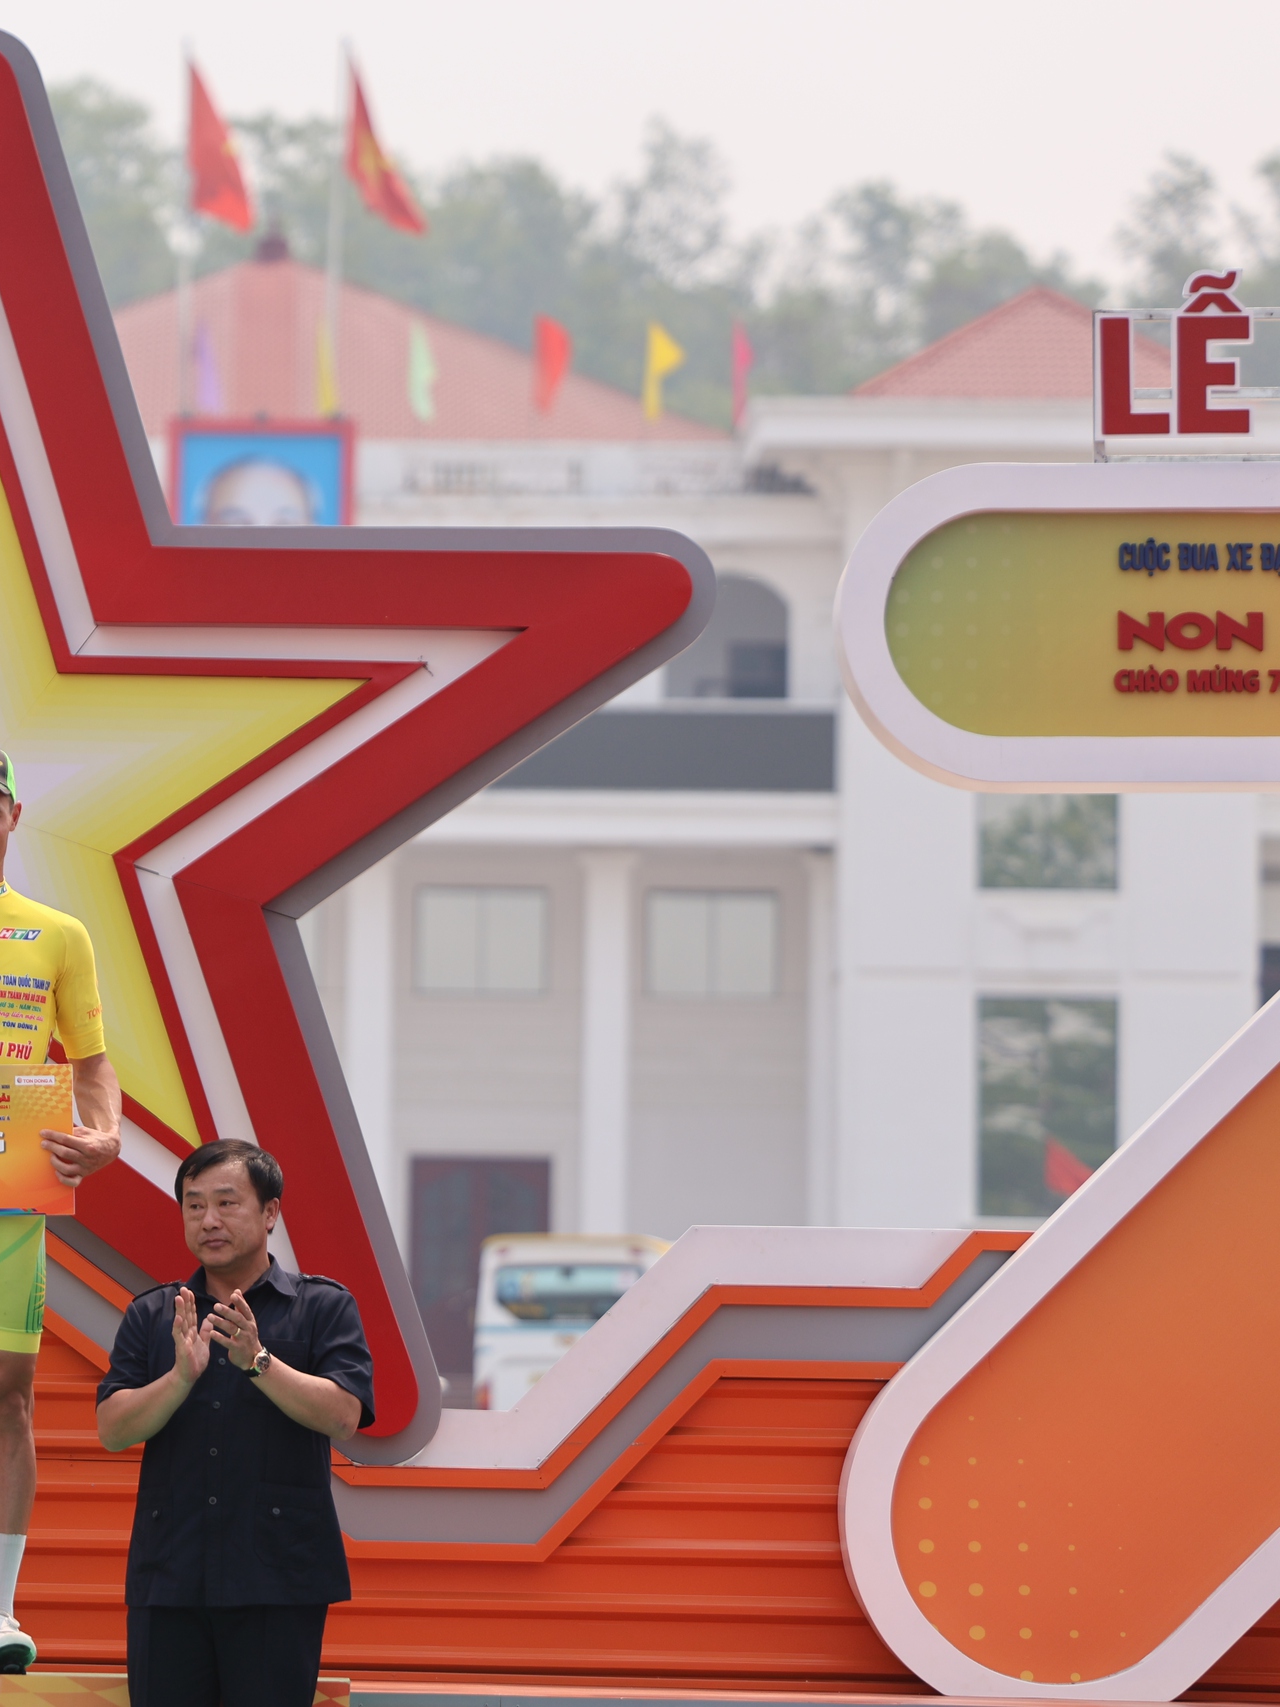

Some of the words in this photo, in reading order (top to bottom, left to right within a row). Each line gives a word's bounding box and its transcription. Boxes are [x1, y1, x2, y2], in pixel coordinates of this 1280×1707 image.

[1099, 270, 1250, 435] LỄ
[1118, 537, 1171, 577] CUỘC
[1177, 543, 1219, 571] ĐUA
[1226, 543, 1254, 571] XE
[1117, 610, 1264, 652] NON
[1114, 664, 1180, 693] CHÀO
[1186, 664, 1261, 693] MỪNG
[6, 1040, 33, 1060] PHỦ
